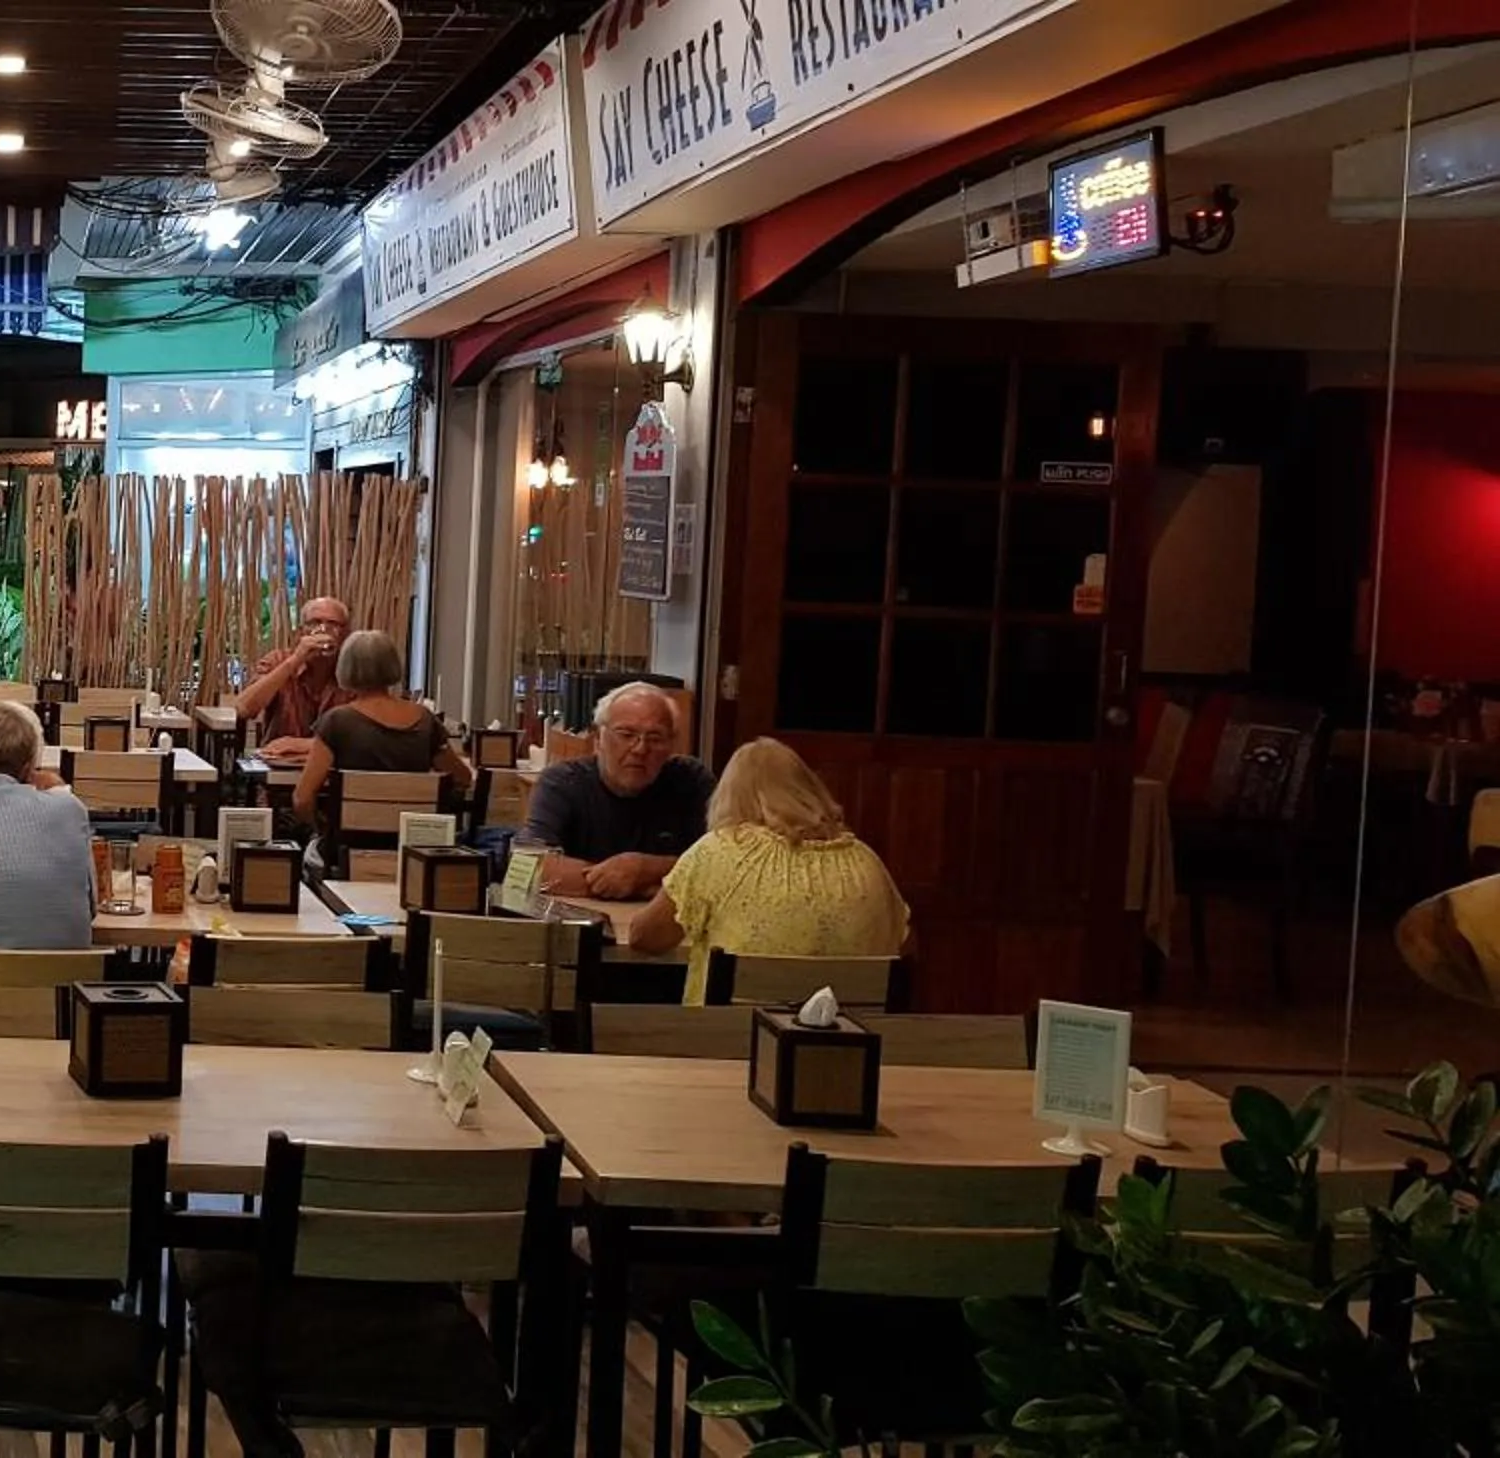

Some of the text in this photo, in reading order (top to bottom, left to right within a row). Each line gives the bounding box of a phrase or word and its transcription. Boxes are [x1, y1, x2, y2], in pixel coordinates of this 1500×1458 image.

[599, 85, 634, 192] SAY
[643, 19, 732, 165] CHEESE
[491, 149, 560, 240] GUESTHOUSE
